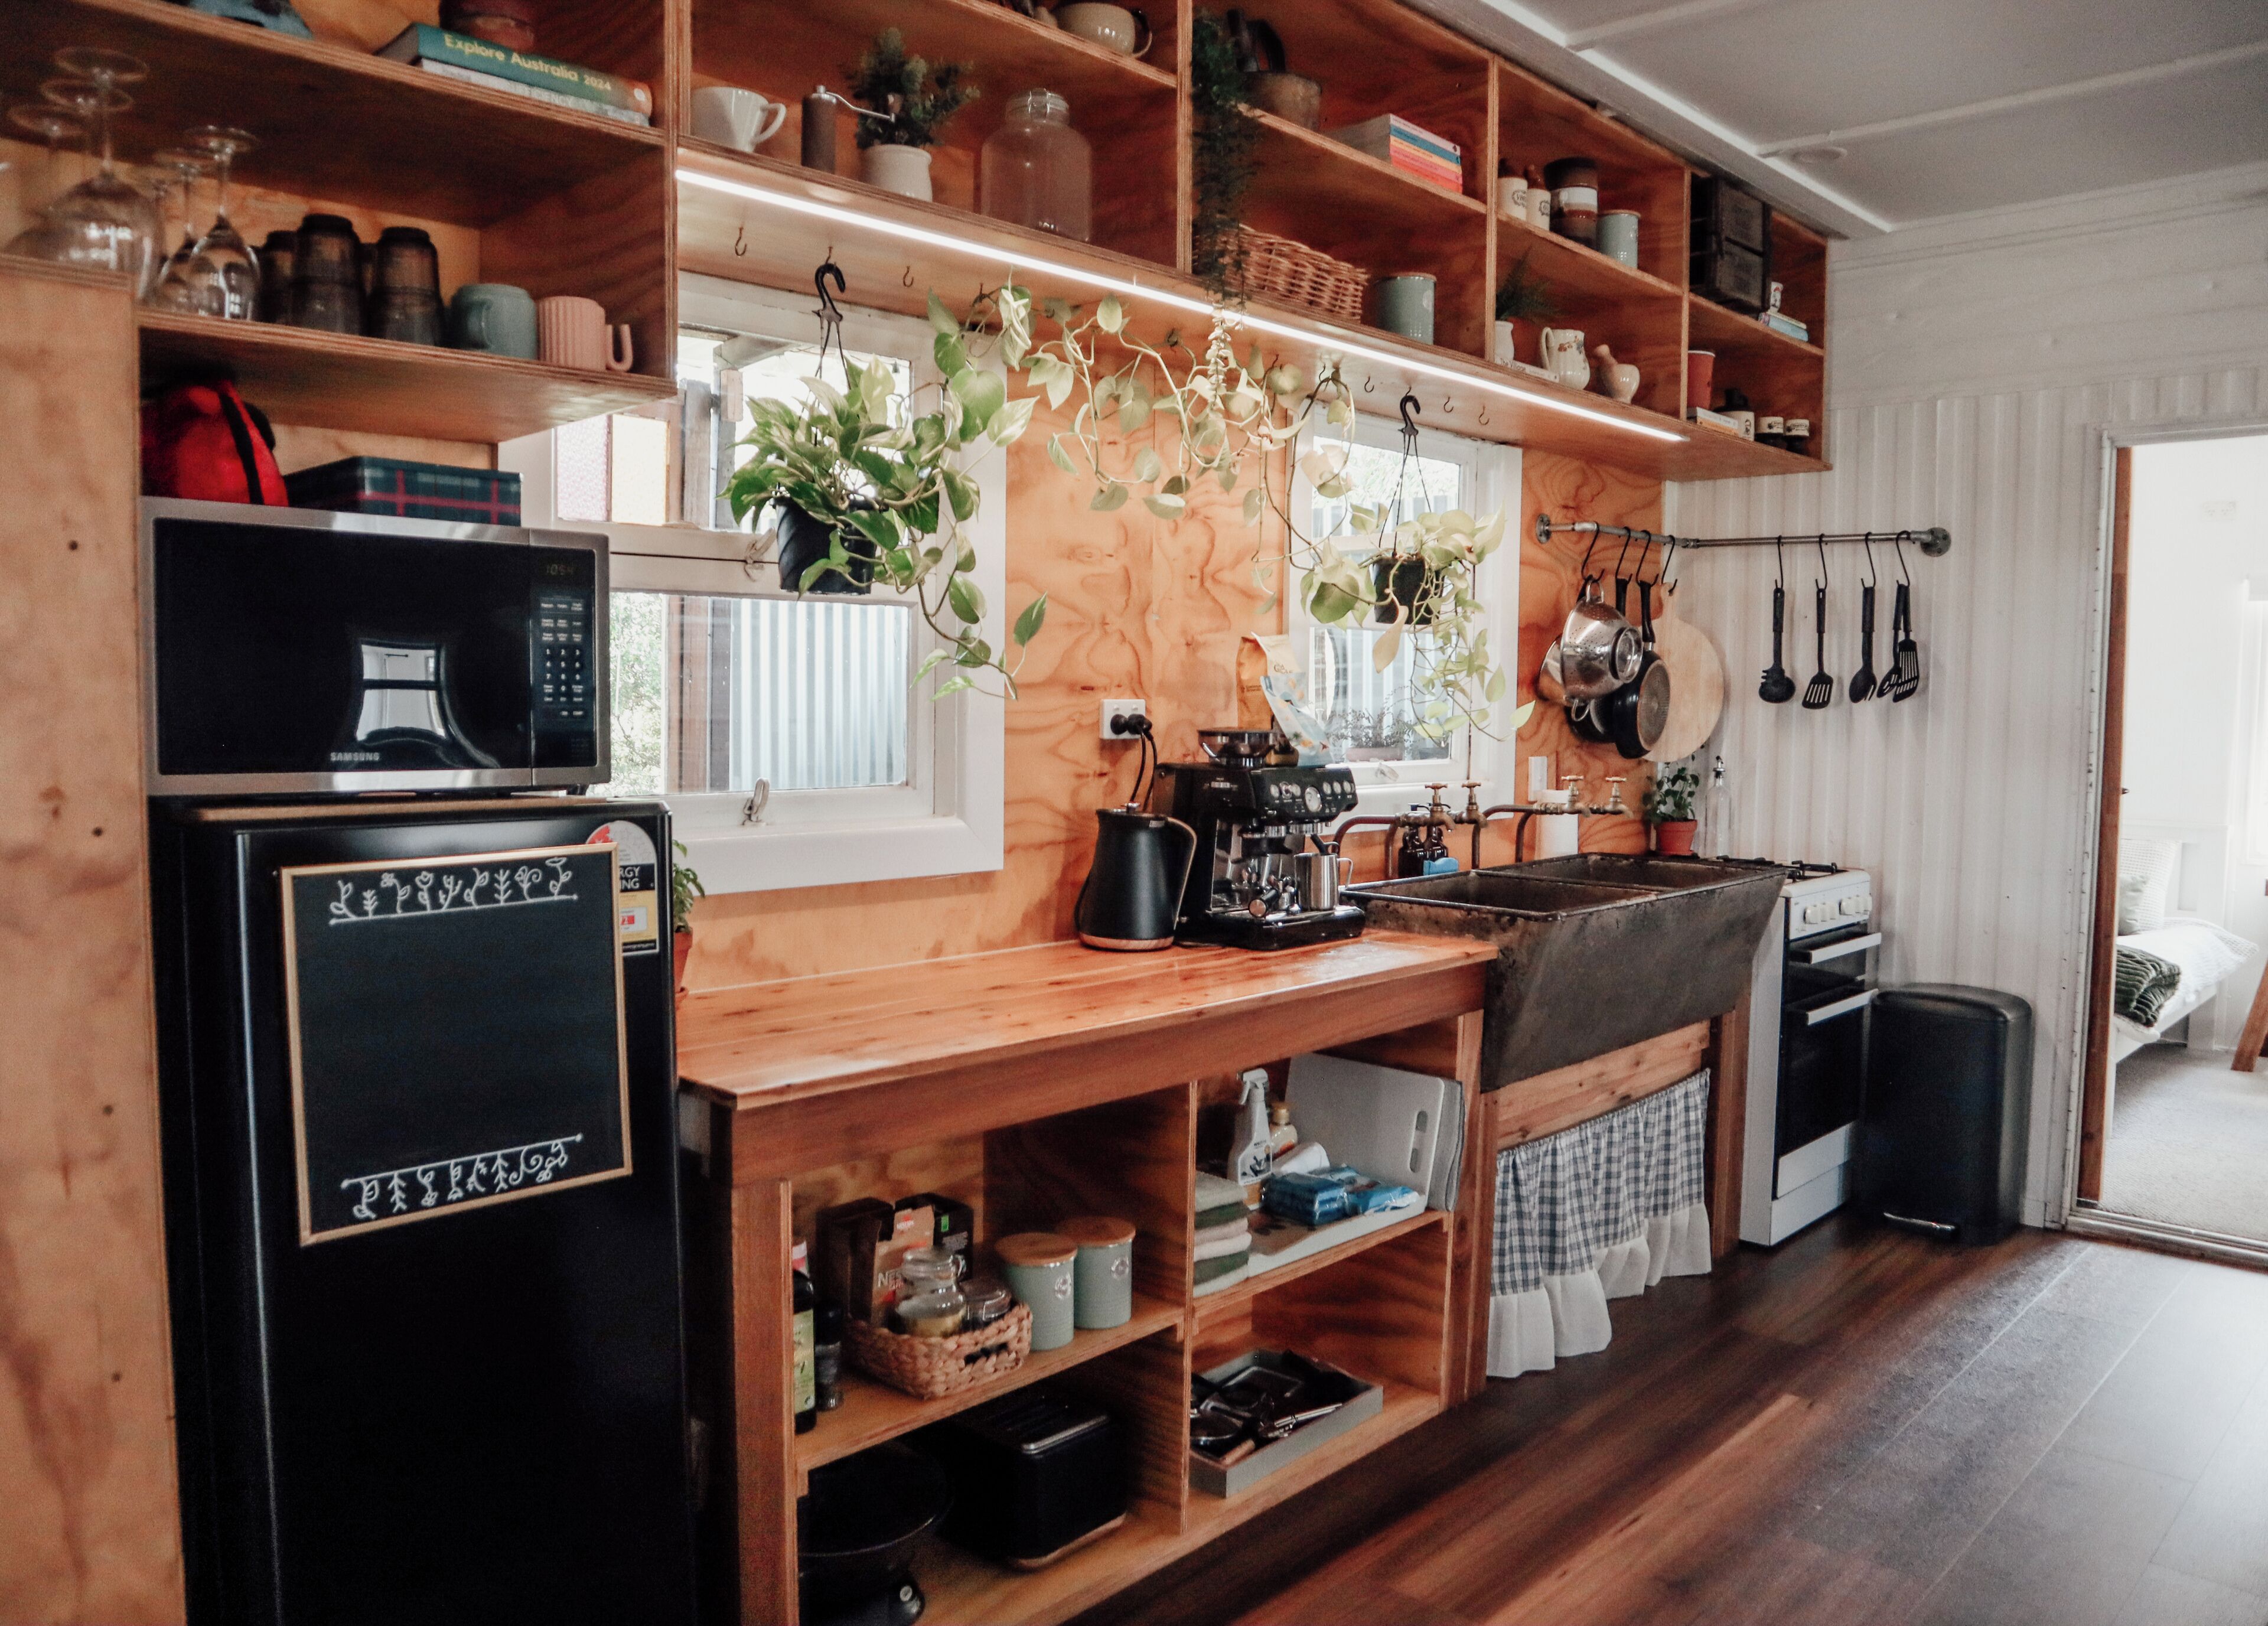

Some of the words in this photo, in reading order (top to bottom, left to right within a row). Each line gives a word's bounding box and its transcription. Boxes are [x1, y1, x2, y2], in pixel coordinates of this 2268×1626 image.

[444, 34, 505, 61] Explore
[511, 51, 579, 82] Australia
[583, 74, 612, 91] 2024
[330, 752, 380, 761] SAMSUNG
